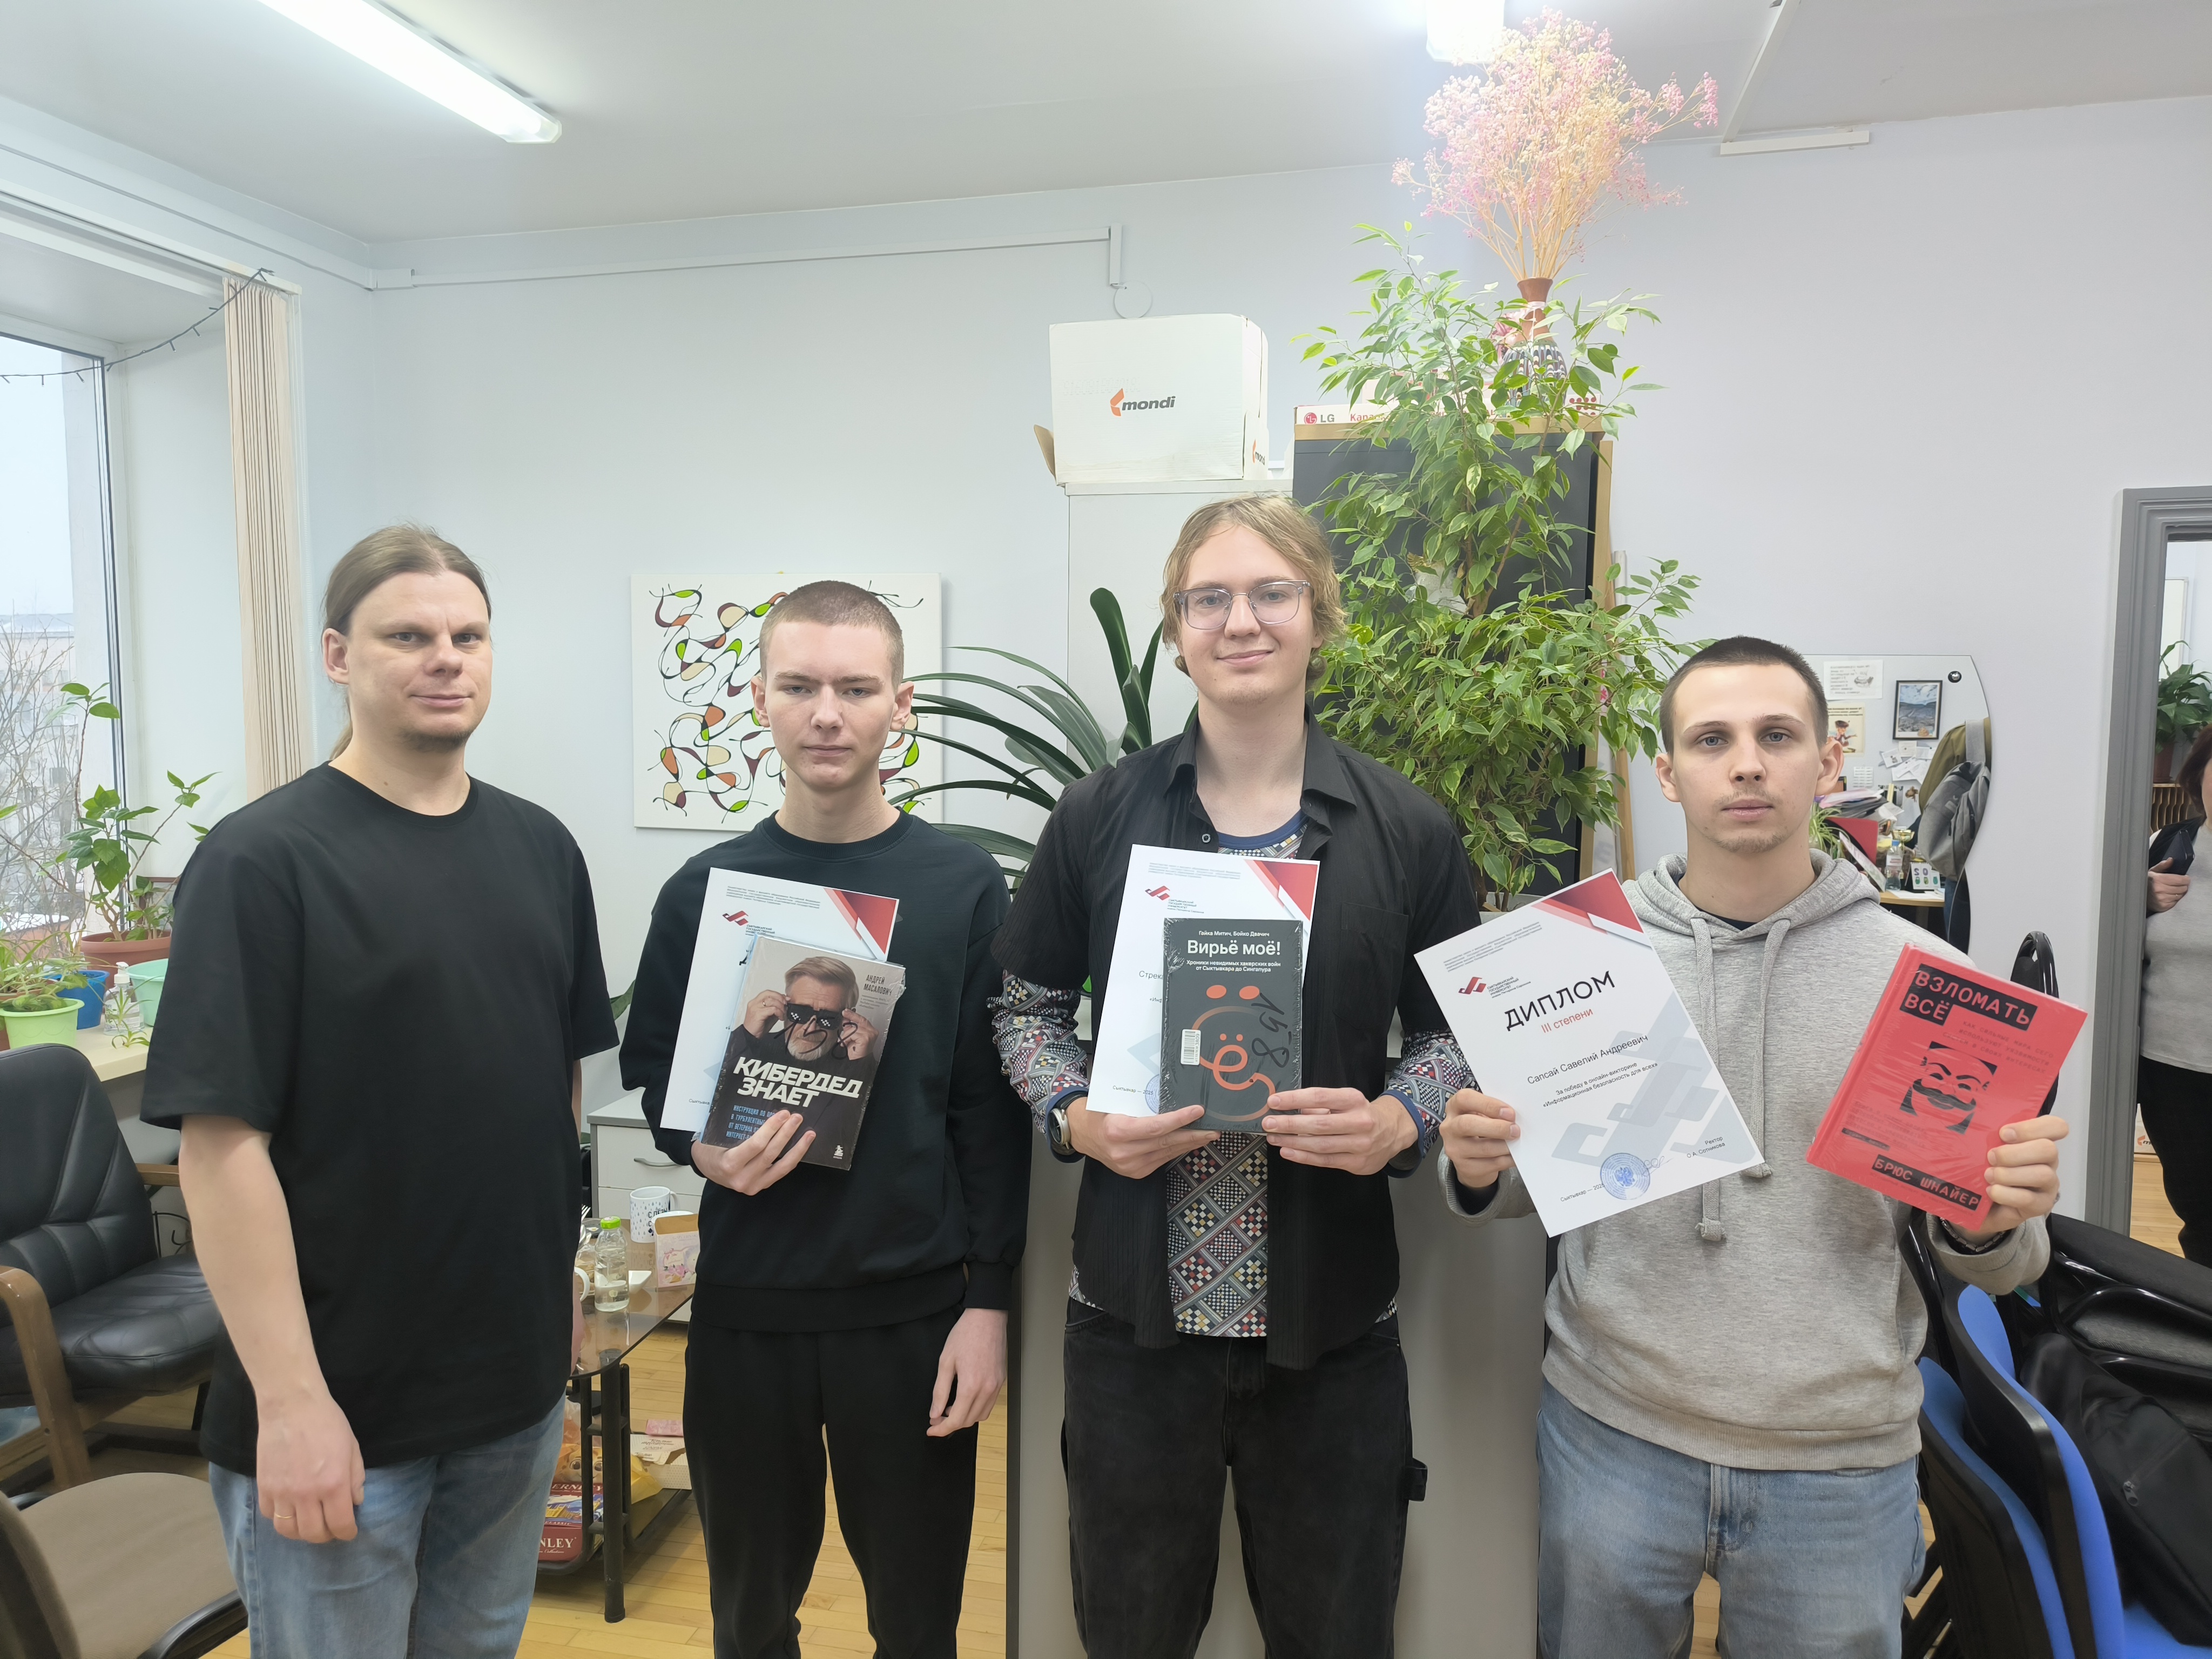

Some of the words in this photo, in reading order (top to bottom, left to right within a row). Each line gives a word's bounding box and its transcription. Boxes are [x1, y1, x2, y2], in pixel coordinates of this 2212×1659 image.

[1122, 396, 1176, 410] mondi
[1320, 414, 1334, 422] LG
[1188, 940, 1238, 957] Вирьё
[1243, 940, 1280, 955] моё!
[866, 974, 885, 984] АНДРЕЙ
[864, 983, 892, 996] МАСАЛОВИЧ
[1914, 969, 2029, 1024] ВЗЛОМАТЬ
[1503, 970, 1615, 1031] ДИПЛОМ
[1904, 992, 1950, 1020] ВСЁ
[1540, 1022, 1552, 1033] III
[1553, 1008, 1593, 1029] степени
[1527, 1067, 1559, 1084] Сапсай
[1560, 1052, 1599, 1072] Савелий
[1600, 1035, 1648, 1057] Андреевич
[733, 1056, 864, 1098] КИБЕРДЕД
[1542, 1086, 1593, 1107] «Информационная
[1592, 1073, 1630, 1089] безопасность
[1630, 1068, 1641, 1076] для
[1641, 1062, 1658, 1071] всех»
[1563, 1082, 1583, 1092] победу
[1588, 1062, 1637, 1083] онлайн-викторине
[737, 1077, 819, 1108] ЗНАЕТ
[733, 1105, 759, 1115] ИНСТРУКЦИЯ
[734, 1123, 752, 1132] ВЕТЕРАНА
[1698, 1142, 1725, 1154] Сотникова
[1704, 1136, 1723, 1145] Ректор
[1874, 1158, 1913, 1180] БРЮС
[1919, 1176, 1982, 1205] ШНАЙЕР
[1560, 1190, 1587, 1202] Сыктывкар
[540, 1537, 574, 1548] NLEY
